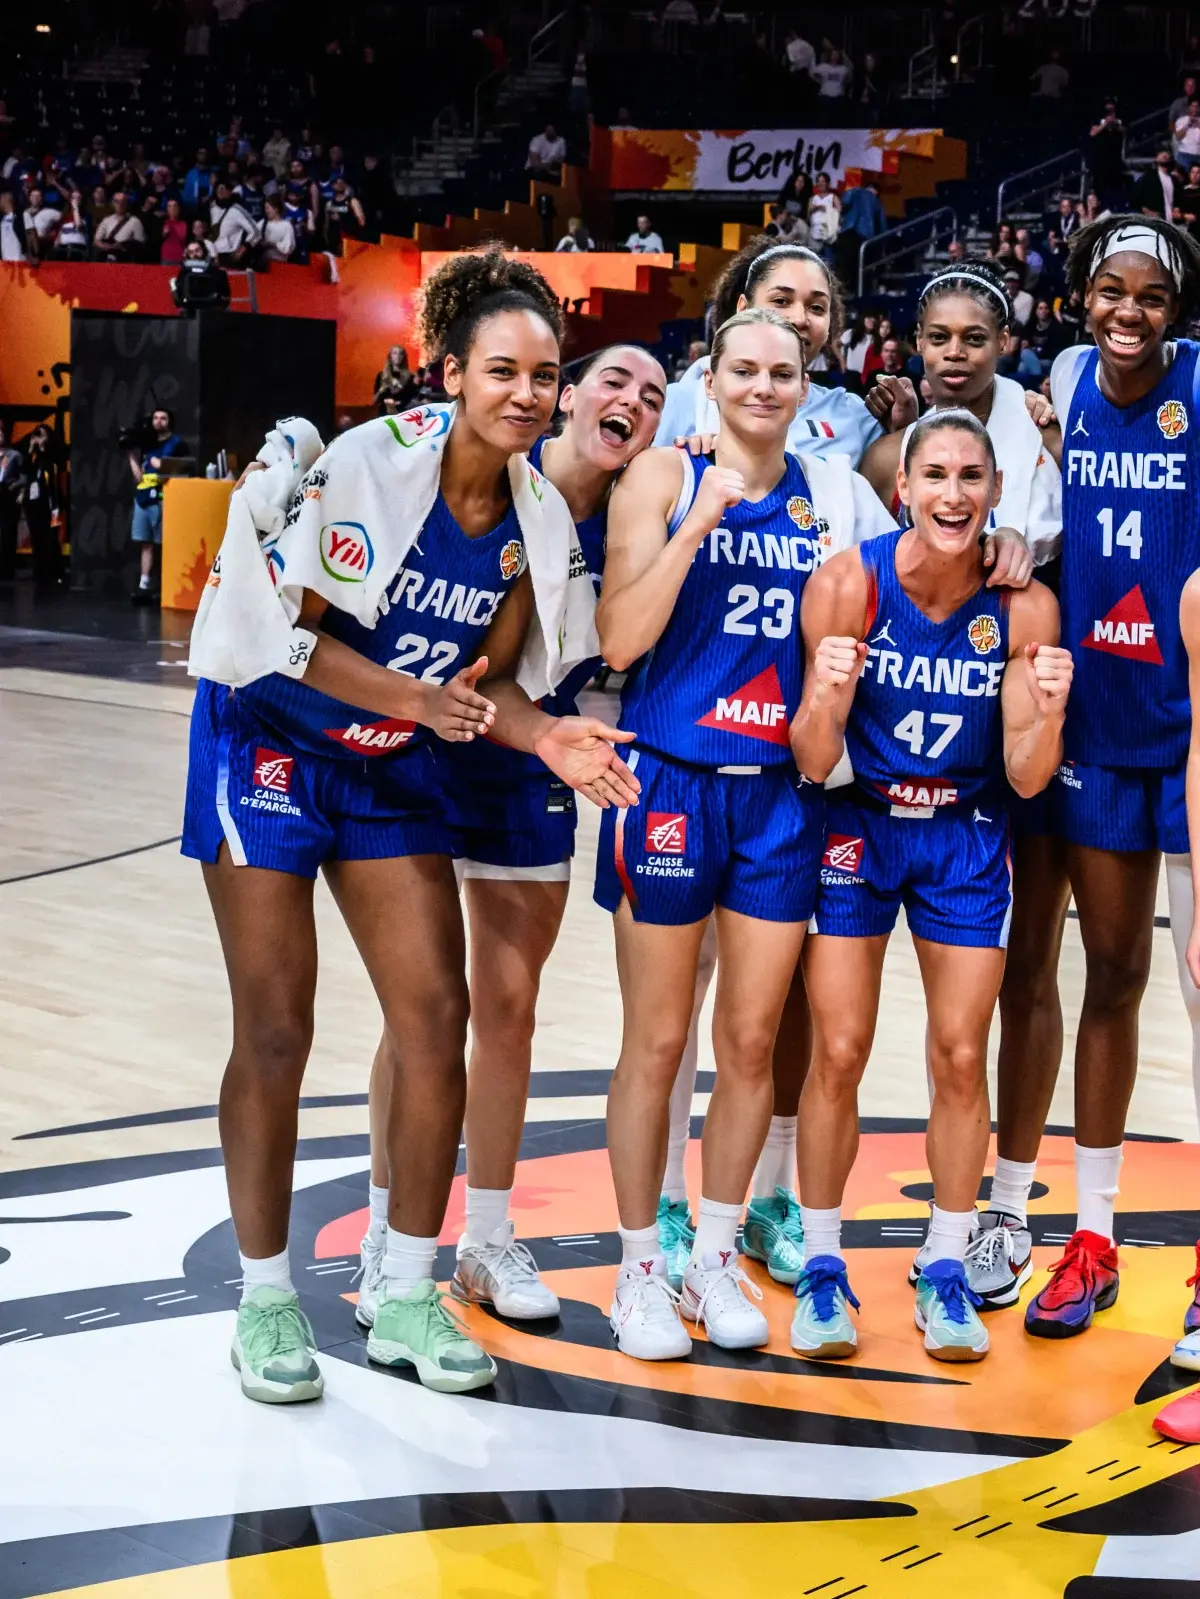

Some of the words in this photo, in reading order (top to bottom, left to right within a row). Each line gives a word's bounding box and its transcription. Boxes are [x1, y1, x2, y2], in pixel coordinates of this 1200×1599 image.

[727, 138, 842, 183] Berlin
[1067, 449, 1187, 490] FRANCE
[1096, 507, 1143, 560] 14
[723, 583, 795, 640] 23
[1094, 619, 1156, 646] MAIF
[386, 632, 460, 687] 22
[715, 697, 787, 727] MAIF
[342, 722, 415, 748] MAIF
[893, 710, 964, 760] 47
[239, 796, 302, 817] D'EPARGNE
[254, 789, 291, 804] CAISSE
[887, 783, 959, 807] MAIF
[636, 864, 695, 878] D'EPARGNE
[647, 856, 683, 868] CAISSE
